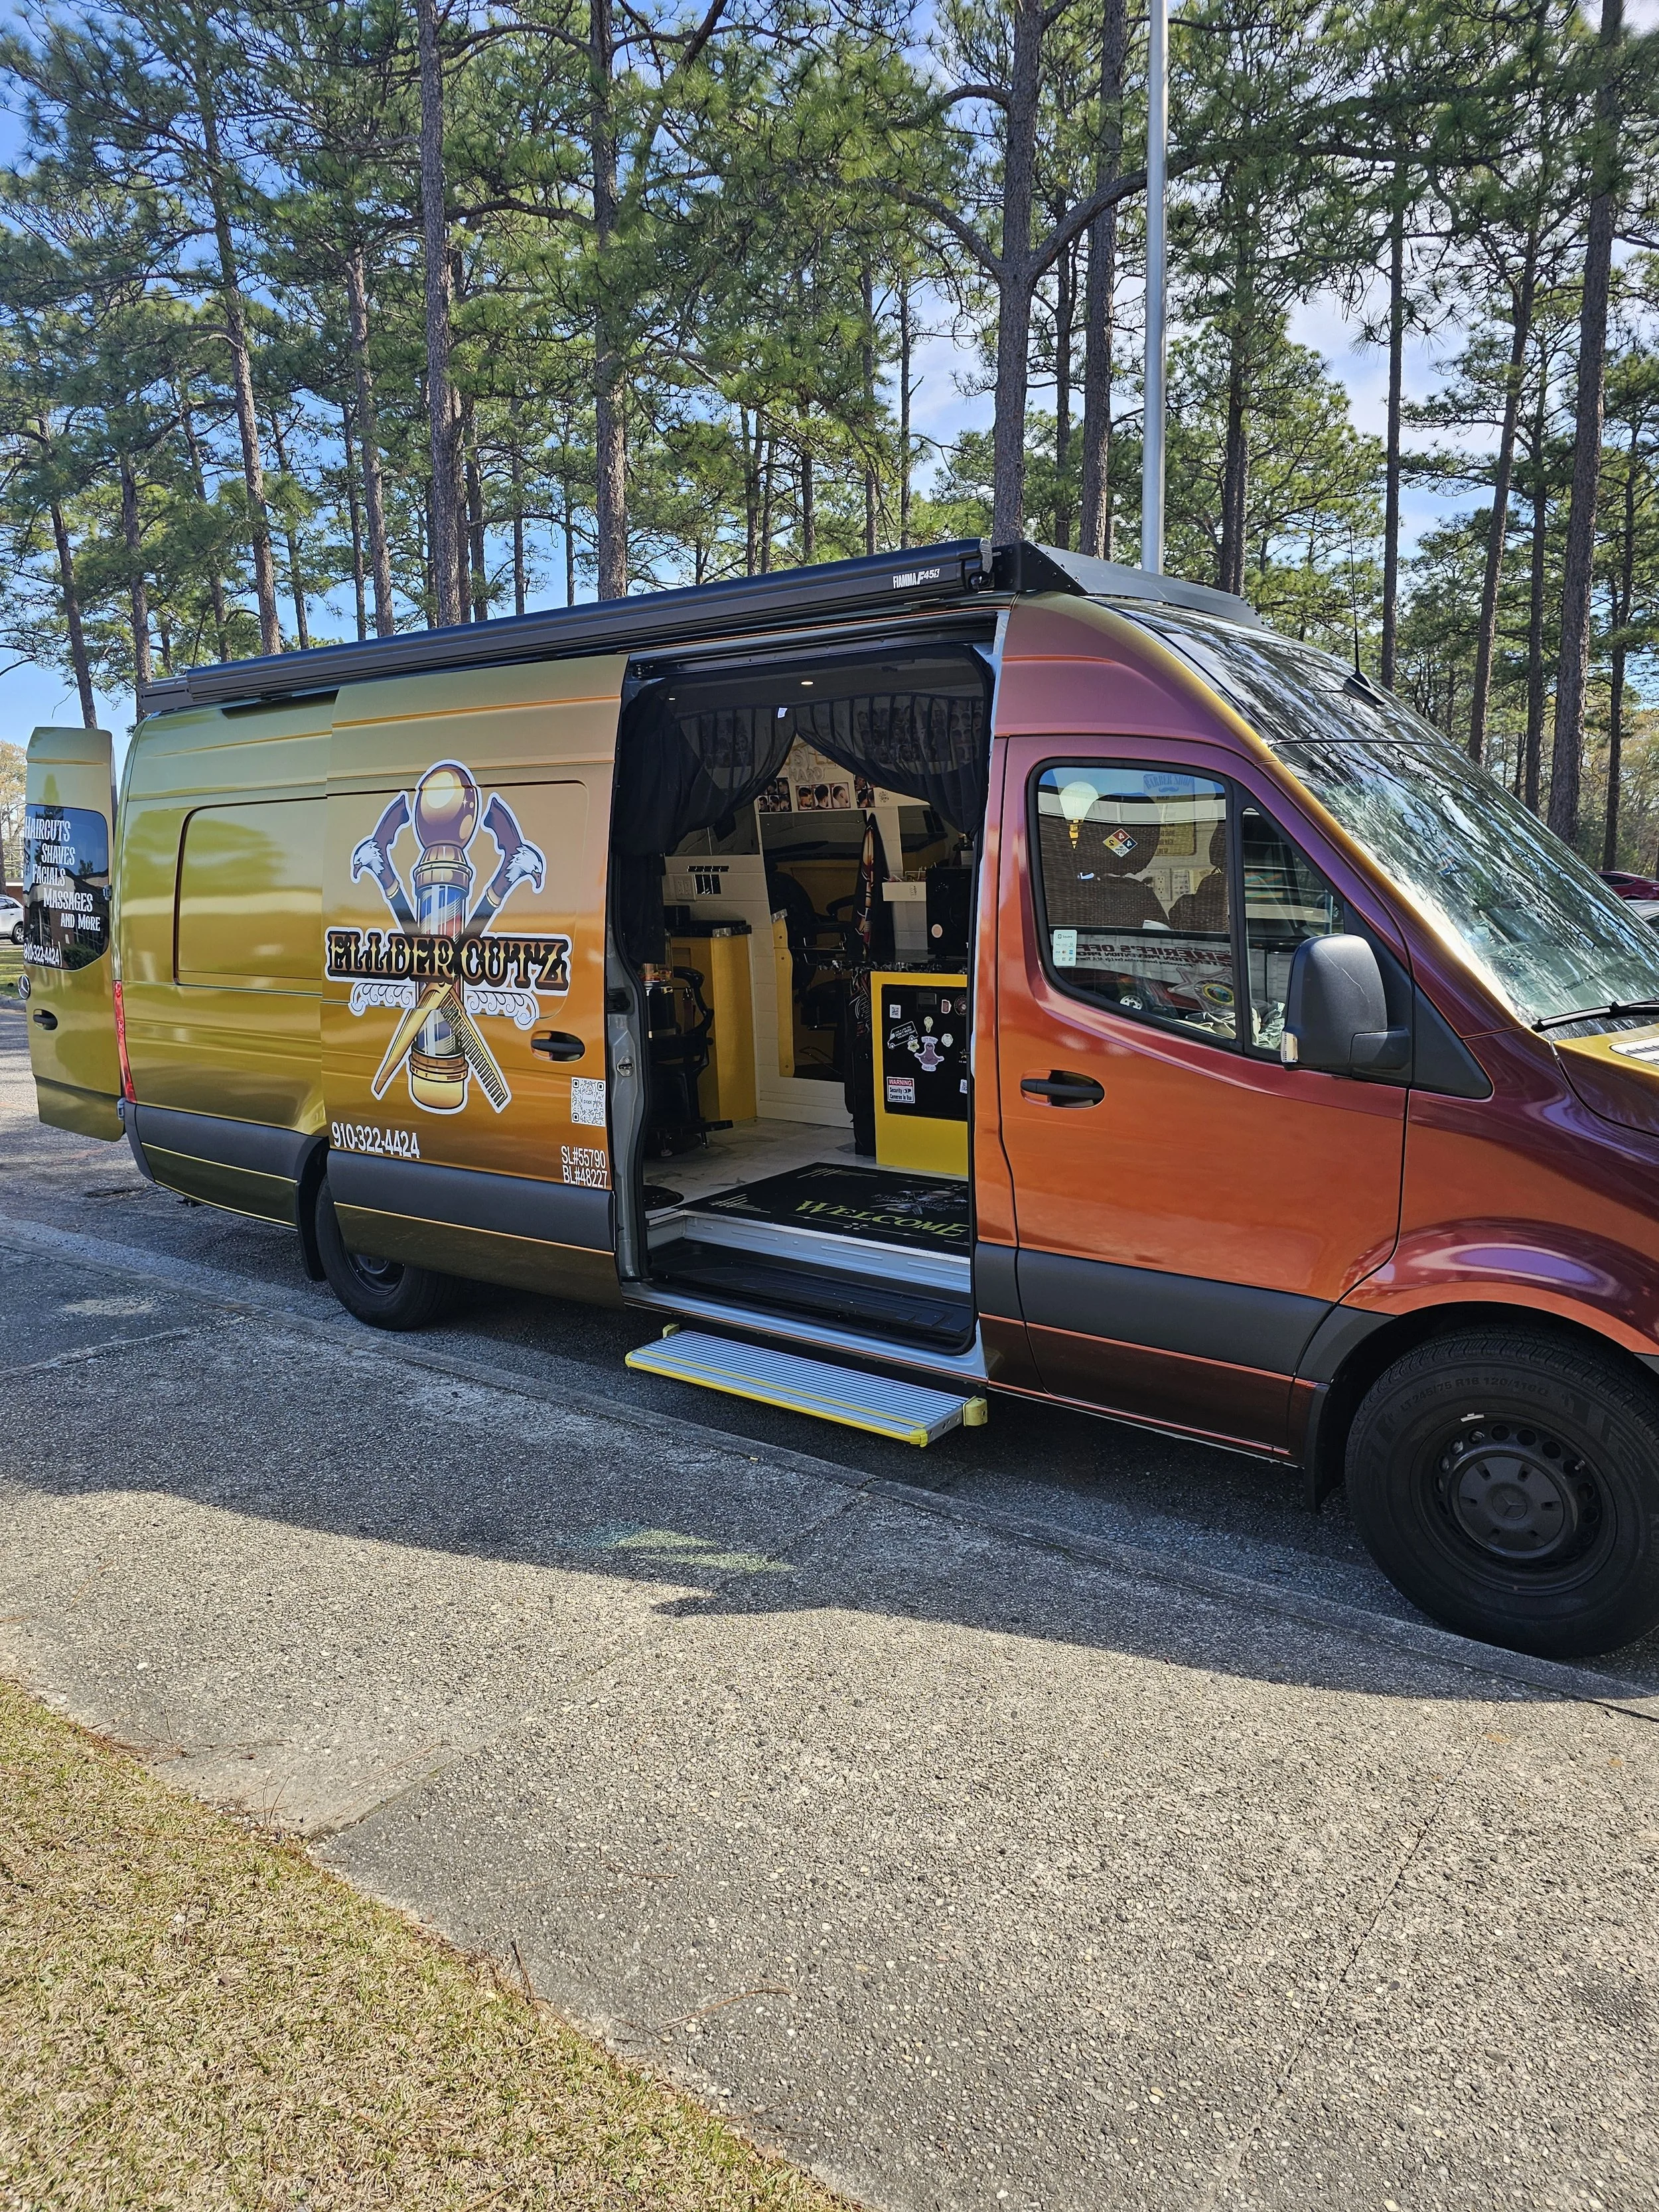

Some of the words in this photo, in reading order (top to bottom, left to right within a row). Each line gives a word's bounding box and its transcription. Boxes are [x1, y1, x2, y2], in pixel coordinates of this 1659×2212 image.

[893, 572, 916, 589] FIAMMA
[25, 816, 71, 842] HAIRCUTS
[41, 843, 76, 865] SHAVES
[32, 864, 66, 886] FACIALS
[43, 887, 94, 913] MASSAGES
[60, 913, 75, 928] AND
[78, 913, 100, 931] MORE
[328, 932, 455, 981] ELLDER
[461, 937, 567, 988] CUTZ
[332, 1122, 420, 1159] 910-322-4424
[561, 1145, 606, 1169] SL#55790
[563, 1165, 607, 1189] BL#48227
[795, 1200, 970, 1237] WELCOME
